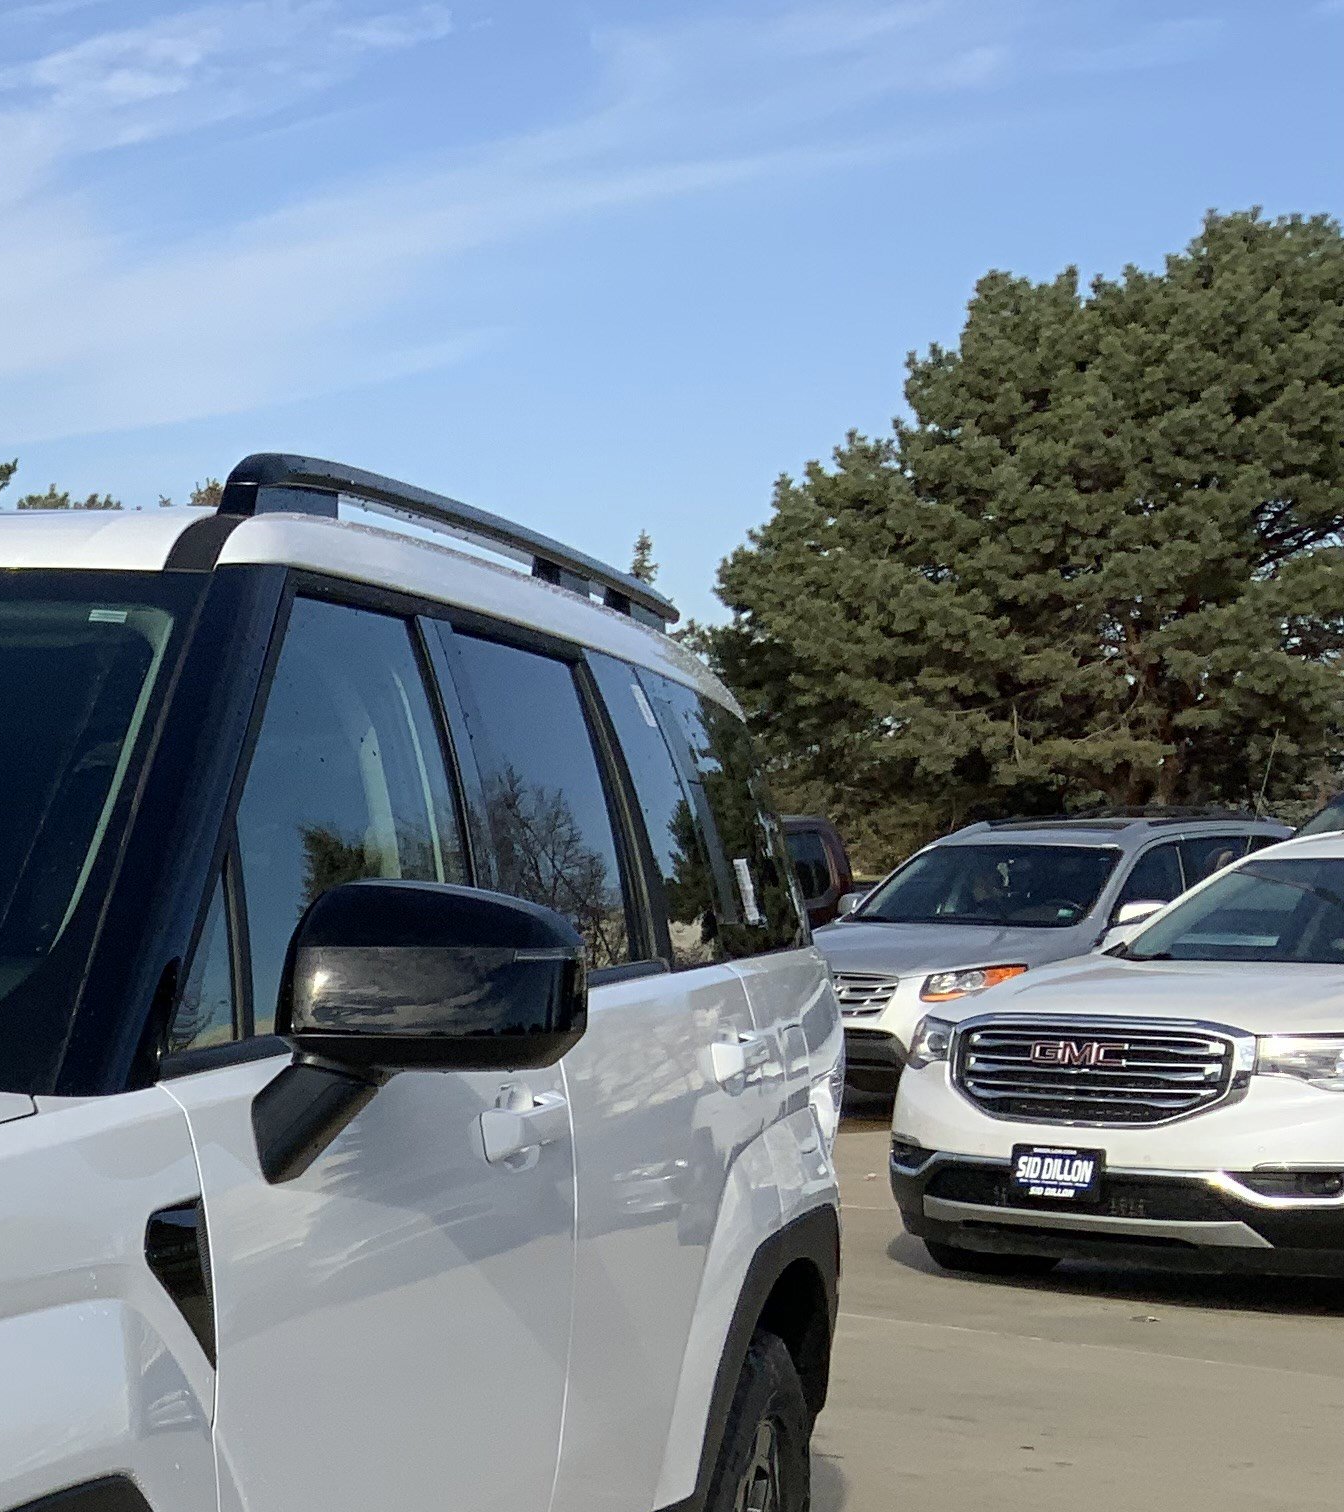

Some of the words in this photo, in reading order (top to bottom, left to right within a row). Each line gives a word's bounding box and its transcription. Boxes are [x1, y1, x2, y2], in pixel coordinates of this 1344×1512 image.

[1030, 1040, 1129, 1067] GMC
[1016, 1156, 1041, 1178] SID
[1041, 1157, 1094, 1183] DILLON
